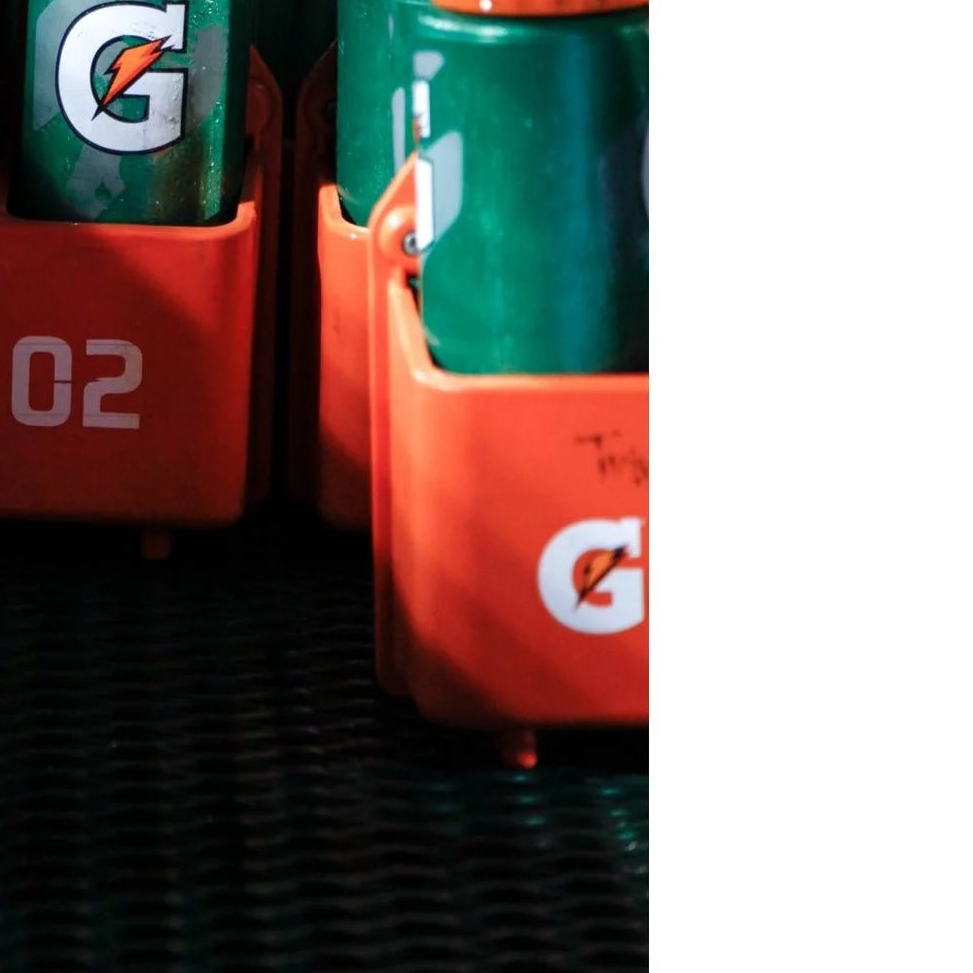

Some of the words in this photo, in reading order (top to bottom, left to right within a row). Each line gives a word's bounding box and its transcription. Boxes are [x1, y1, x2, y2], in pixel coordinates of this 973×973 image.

[57, 1, 187, 155] G
[11, 335, 143, 429] 02
[537, 516, 644, 635] G
